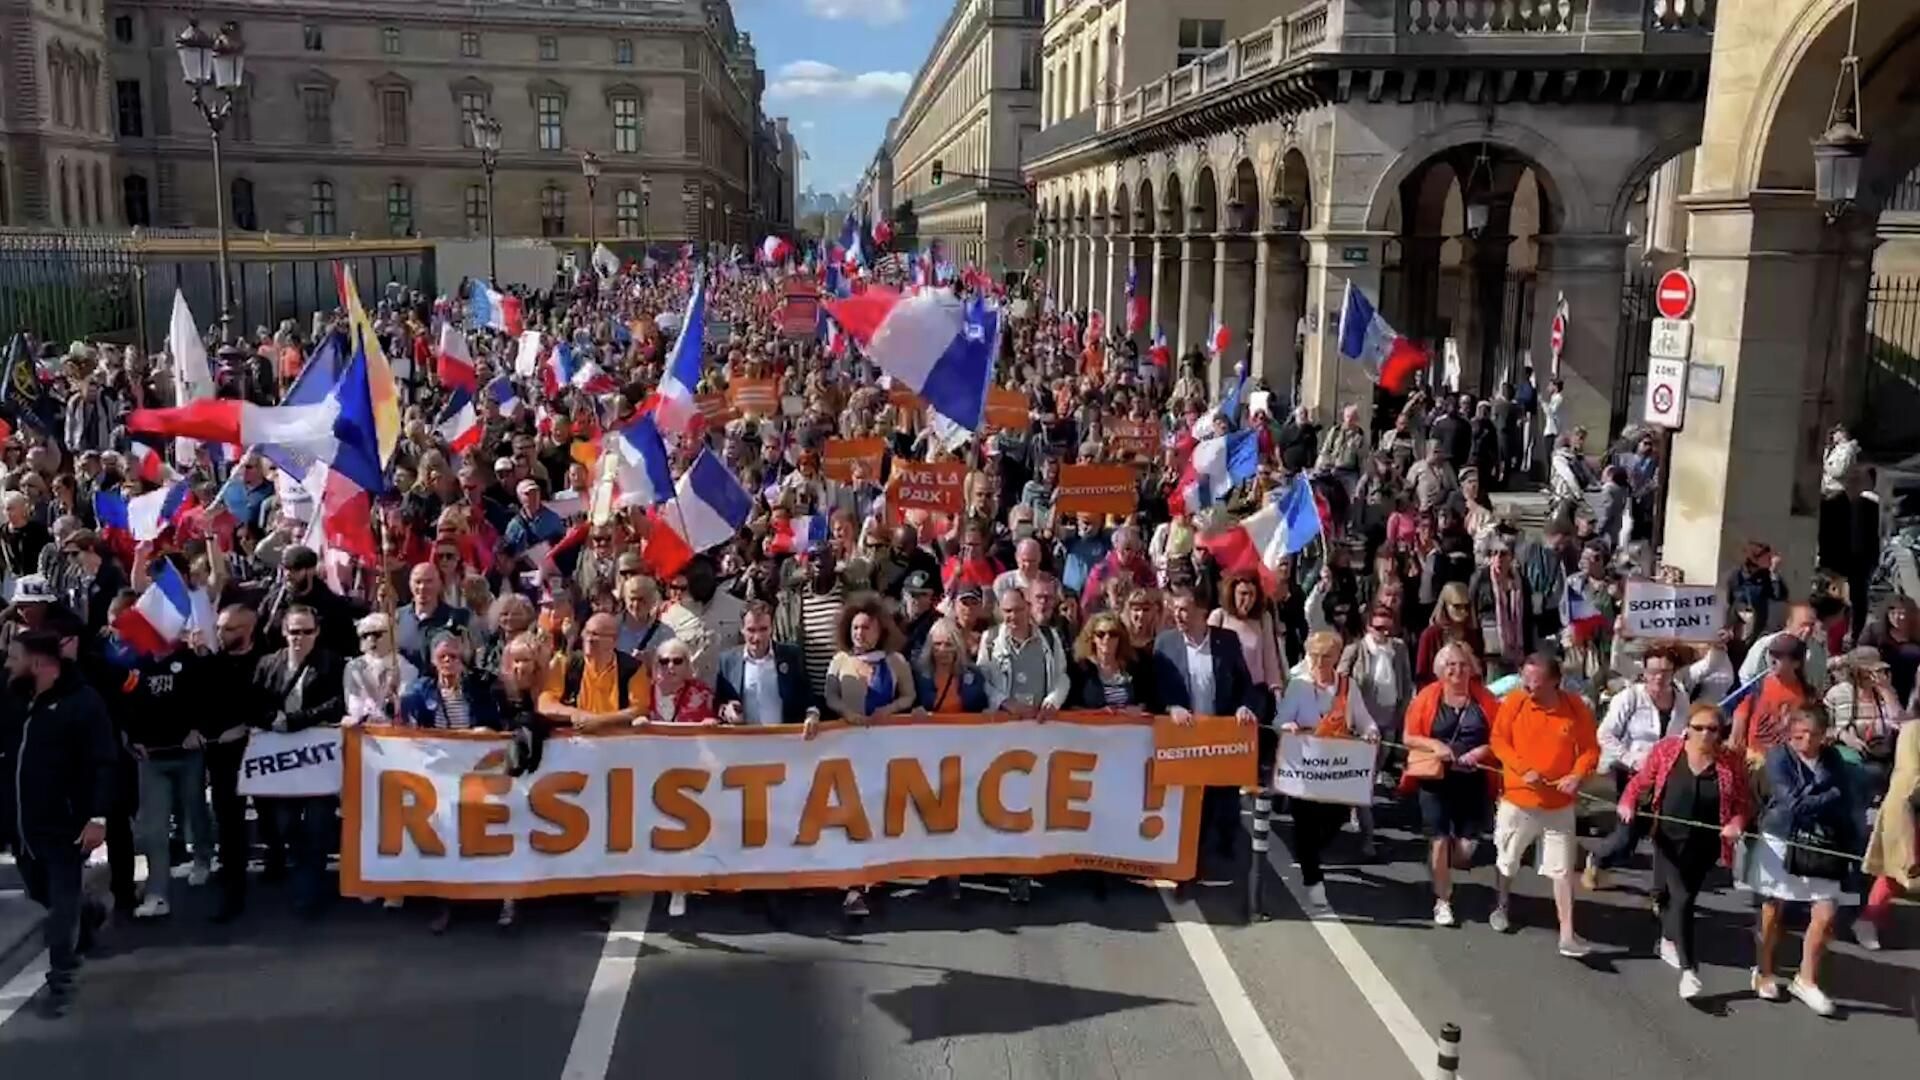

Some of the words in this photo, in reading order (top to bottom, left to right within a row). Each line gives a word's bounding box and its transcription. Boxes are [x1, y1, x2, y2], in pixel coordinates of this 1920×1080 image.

[936, 471, 959, 485] LA
[898, 486, 941, 504] PAIX
[1629, 598, 1691, 612] SORTIR
[1695, 595, 1717, 607] DE
[1640, 614, 1701, 629] L'OTAN
[1705, 614, 1711, 626] !
[1156, 742, 1250, 760] DESTITUTION
[245, 742, 337, 779] FREXIT
[1302, 756, 1331, 768] NON
[1332, 756, 1348, 767] AU
[1277, 767, 1371, 781] RATIONNEMENT
[377, 749, 1098, 857] RÉSISTANCE
[1138, 757, 1165, 840] !
